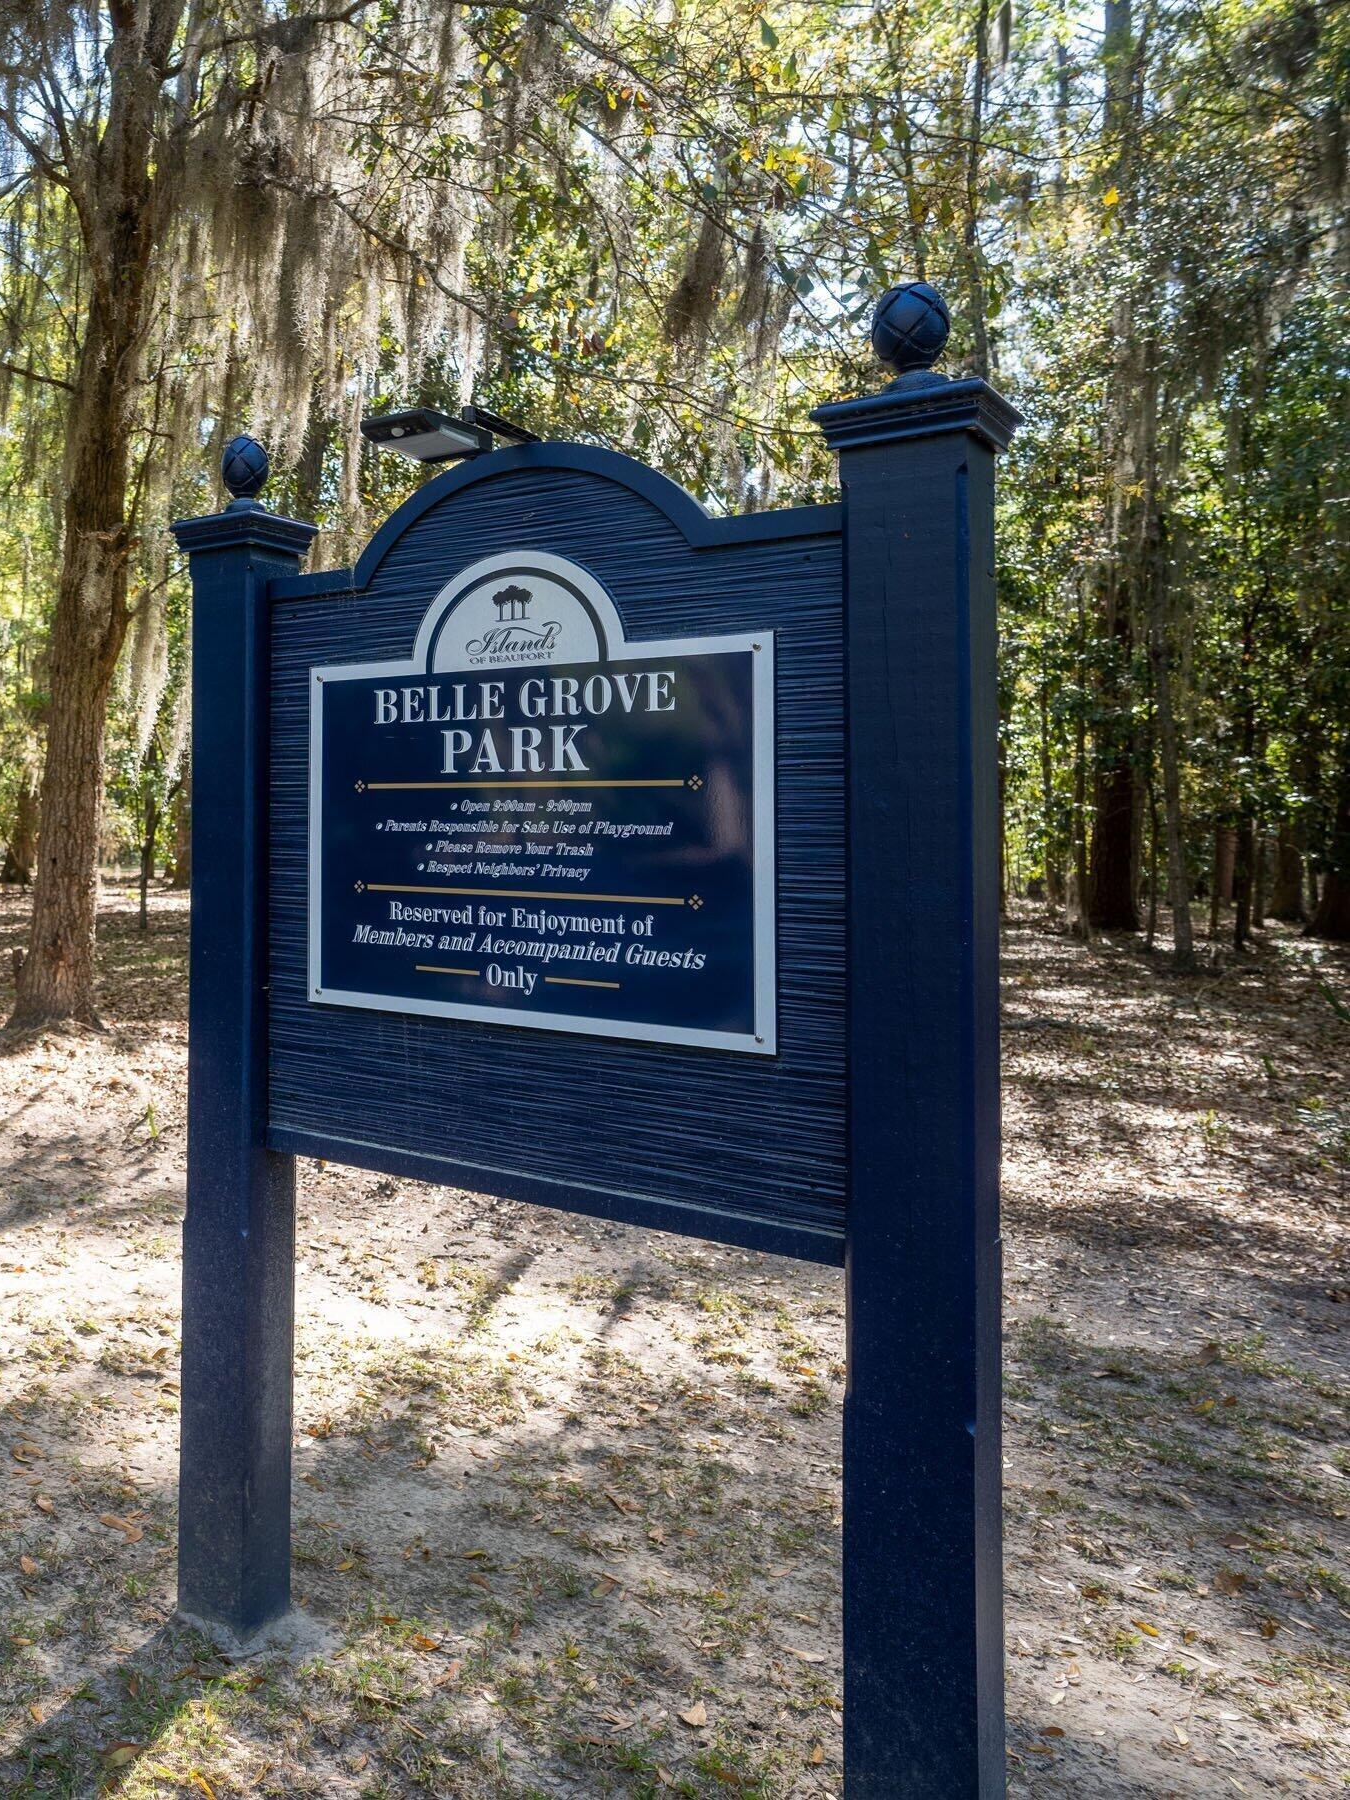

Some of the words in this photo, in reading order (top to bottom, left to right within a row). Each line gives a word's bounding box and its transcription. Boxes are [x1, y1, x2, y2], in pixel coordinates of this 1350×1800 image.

[465, 621, 562, 656] Islands
[469, 656, 487, 665] OF
[489, 651, 555, 664] BEAUFORT
[374, 682, 505, 725] BELLE
[519, 671, 676, 719] GROVE
[441, 724, 590, 775] PARK
[460, 799, 491, 815] Open
[492, 799, 537, 812] 9:00am
[546, 799, 592, 815] 9:00pm
[385, 819, 427, 832] Parents
[428, 819, 499, 835] Responsible
[500, 820, 520, 833] for
[521, 820, 550, 834] Safe
[552, 821, 576, 834] Use
[578, 821, 593, 834] of
[594, 821, 674, 838] Playground
[435, 840, 473, 853] Please
[475, 841, 523, 855] Remove
[525, 842, 553, 855] Your
[556, 842, 594, 856] Trash
[427, 860, 473, 876] Respect
[541, 863, 591, 881] Privacy
[389, 900, 474, 925] Reserved
[477, 905, 506, 927] for
[511, 907, 626, 937] Enjoyment
[631, 914, 654, 937] of
[352, 924, 435, 949] Members
[437, 932, 476, 952] and
[477, 933, 621, 964] Accompanied
[625, 943, 706, 970] Guests
[485, 963, 538, 995] Only
